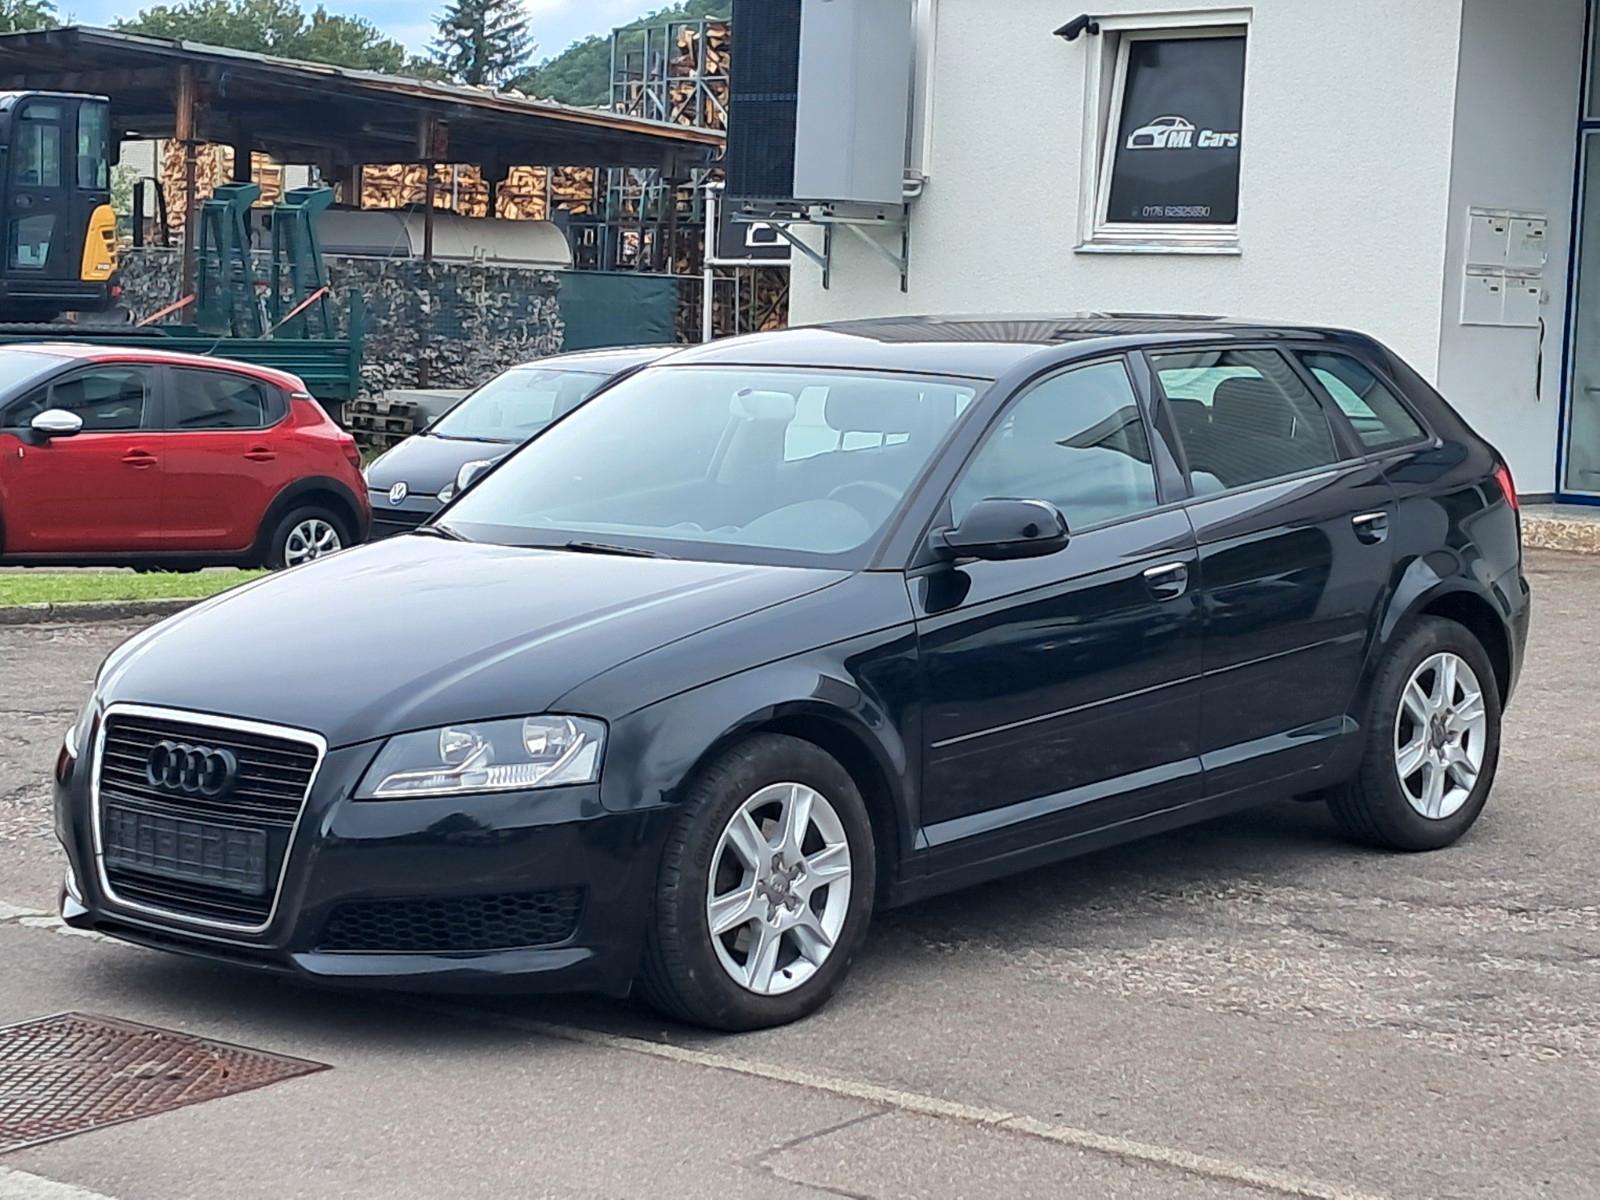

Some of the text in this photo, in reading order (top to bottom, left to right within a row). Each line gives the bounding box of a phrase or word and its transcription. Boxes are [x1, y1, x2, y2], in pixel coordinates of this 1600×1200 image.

[1166, 130, 1239, 148] ML Cars
[1142, 206, 1163, 217] 0176
